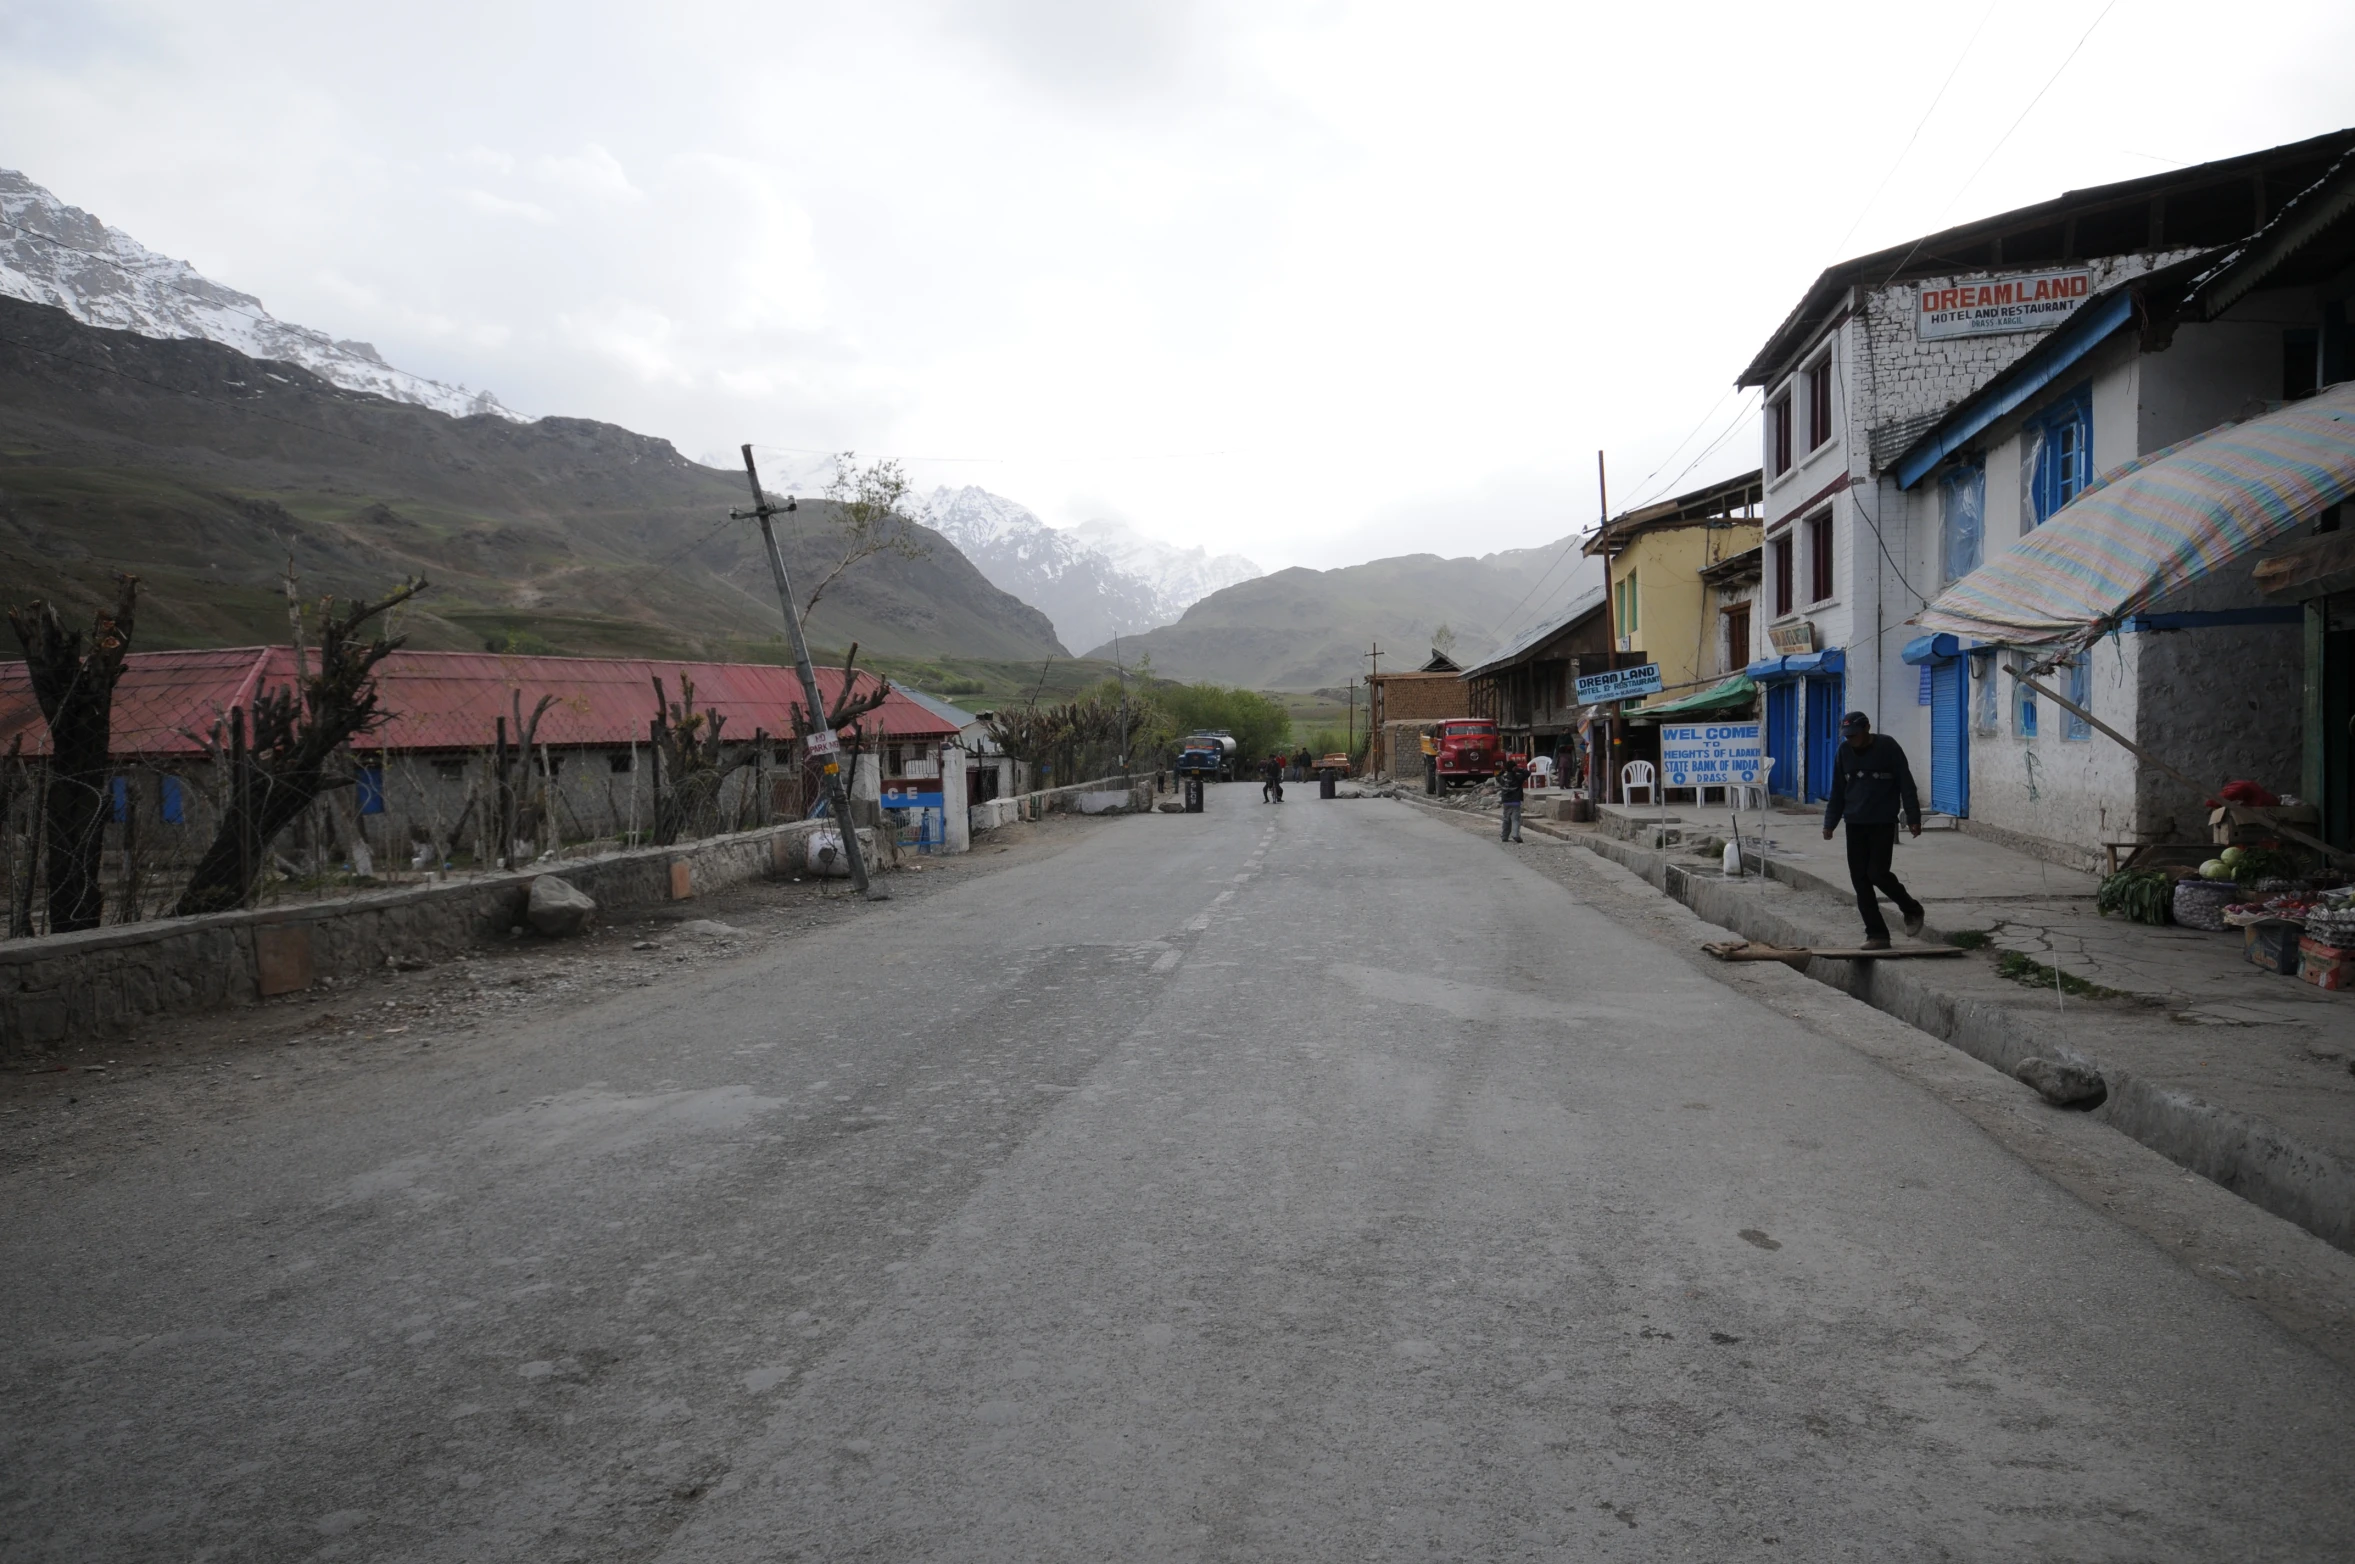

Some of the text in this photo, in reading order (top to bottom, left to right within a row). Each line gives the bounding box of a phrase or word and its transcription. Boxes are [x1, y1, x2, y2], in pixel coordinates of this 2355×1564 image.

[1931, 300, 2075, 324] HOTEL AND RESTAURANT
[1578, 666, 1655, 689] DREAM LAND
[1577, 687, 1602, 696] HOTEL
[1614, 676, 1660, 690] RESTAURANT
[815, 733, 826, 743] NO
[810, 741, 839, 753] PARKNG
[1664, 748, 1761, 759] HEIGHTS OF LADAKH
[1664, 759, 1759, 772] STATE BANK OF INDIA
[1697, 773, 1728, 782] DRASS
